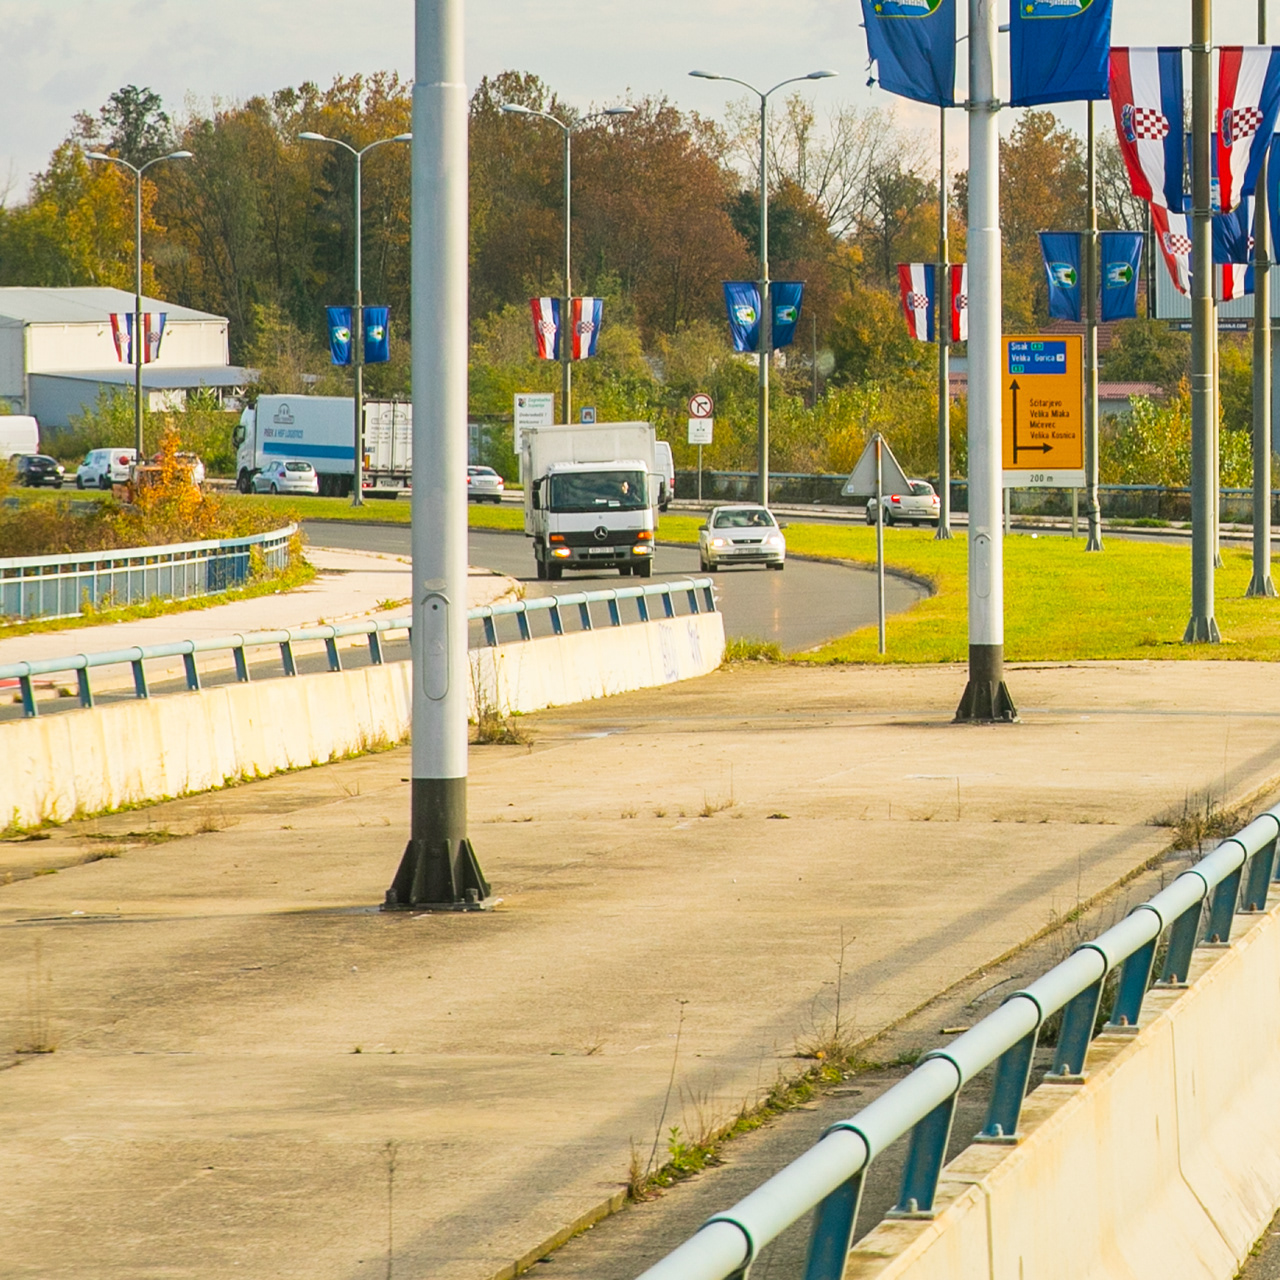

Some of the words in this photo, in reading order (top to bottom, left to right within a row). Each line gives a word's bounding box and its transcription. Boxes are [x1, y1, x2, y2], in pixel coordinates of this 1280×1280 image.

[1011, 342, 1028, 351] Sisak
[1011, 353, 1031, 362] Velika
[1034, 353, 1055, 362] Gorica
[1030, 410, 1049, 418] Velika
[1051, 410, 1070, 418] Mlaka
[1030, 431, 1050, 439] Velika
[1030, 474, 1044, 483] 200
